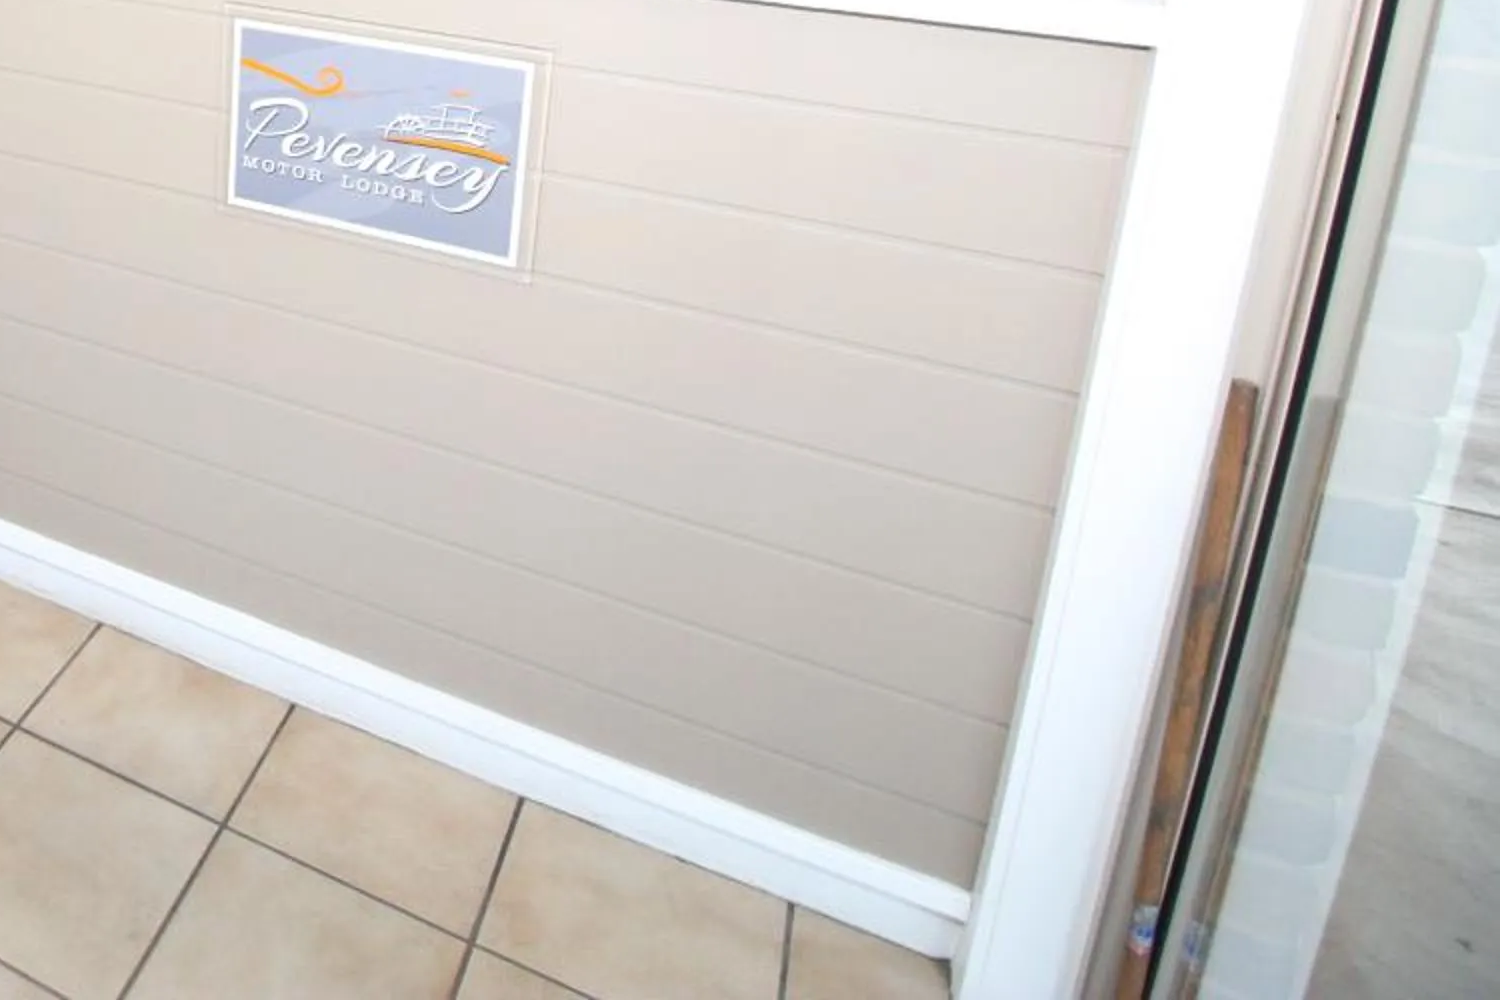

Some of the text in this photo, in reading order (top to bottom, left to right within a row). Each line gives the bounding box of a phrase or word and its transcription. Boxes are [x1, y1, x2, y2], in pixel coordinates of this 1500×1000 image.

[242, 155, 426, 205] MOTOR LODGE
[243, 98, 510, 214] Pevensey
